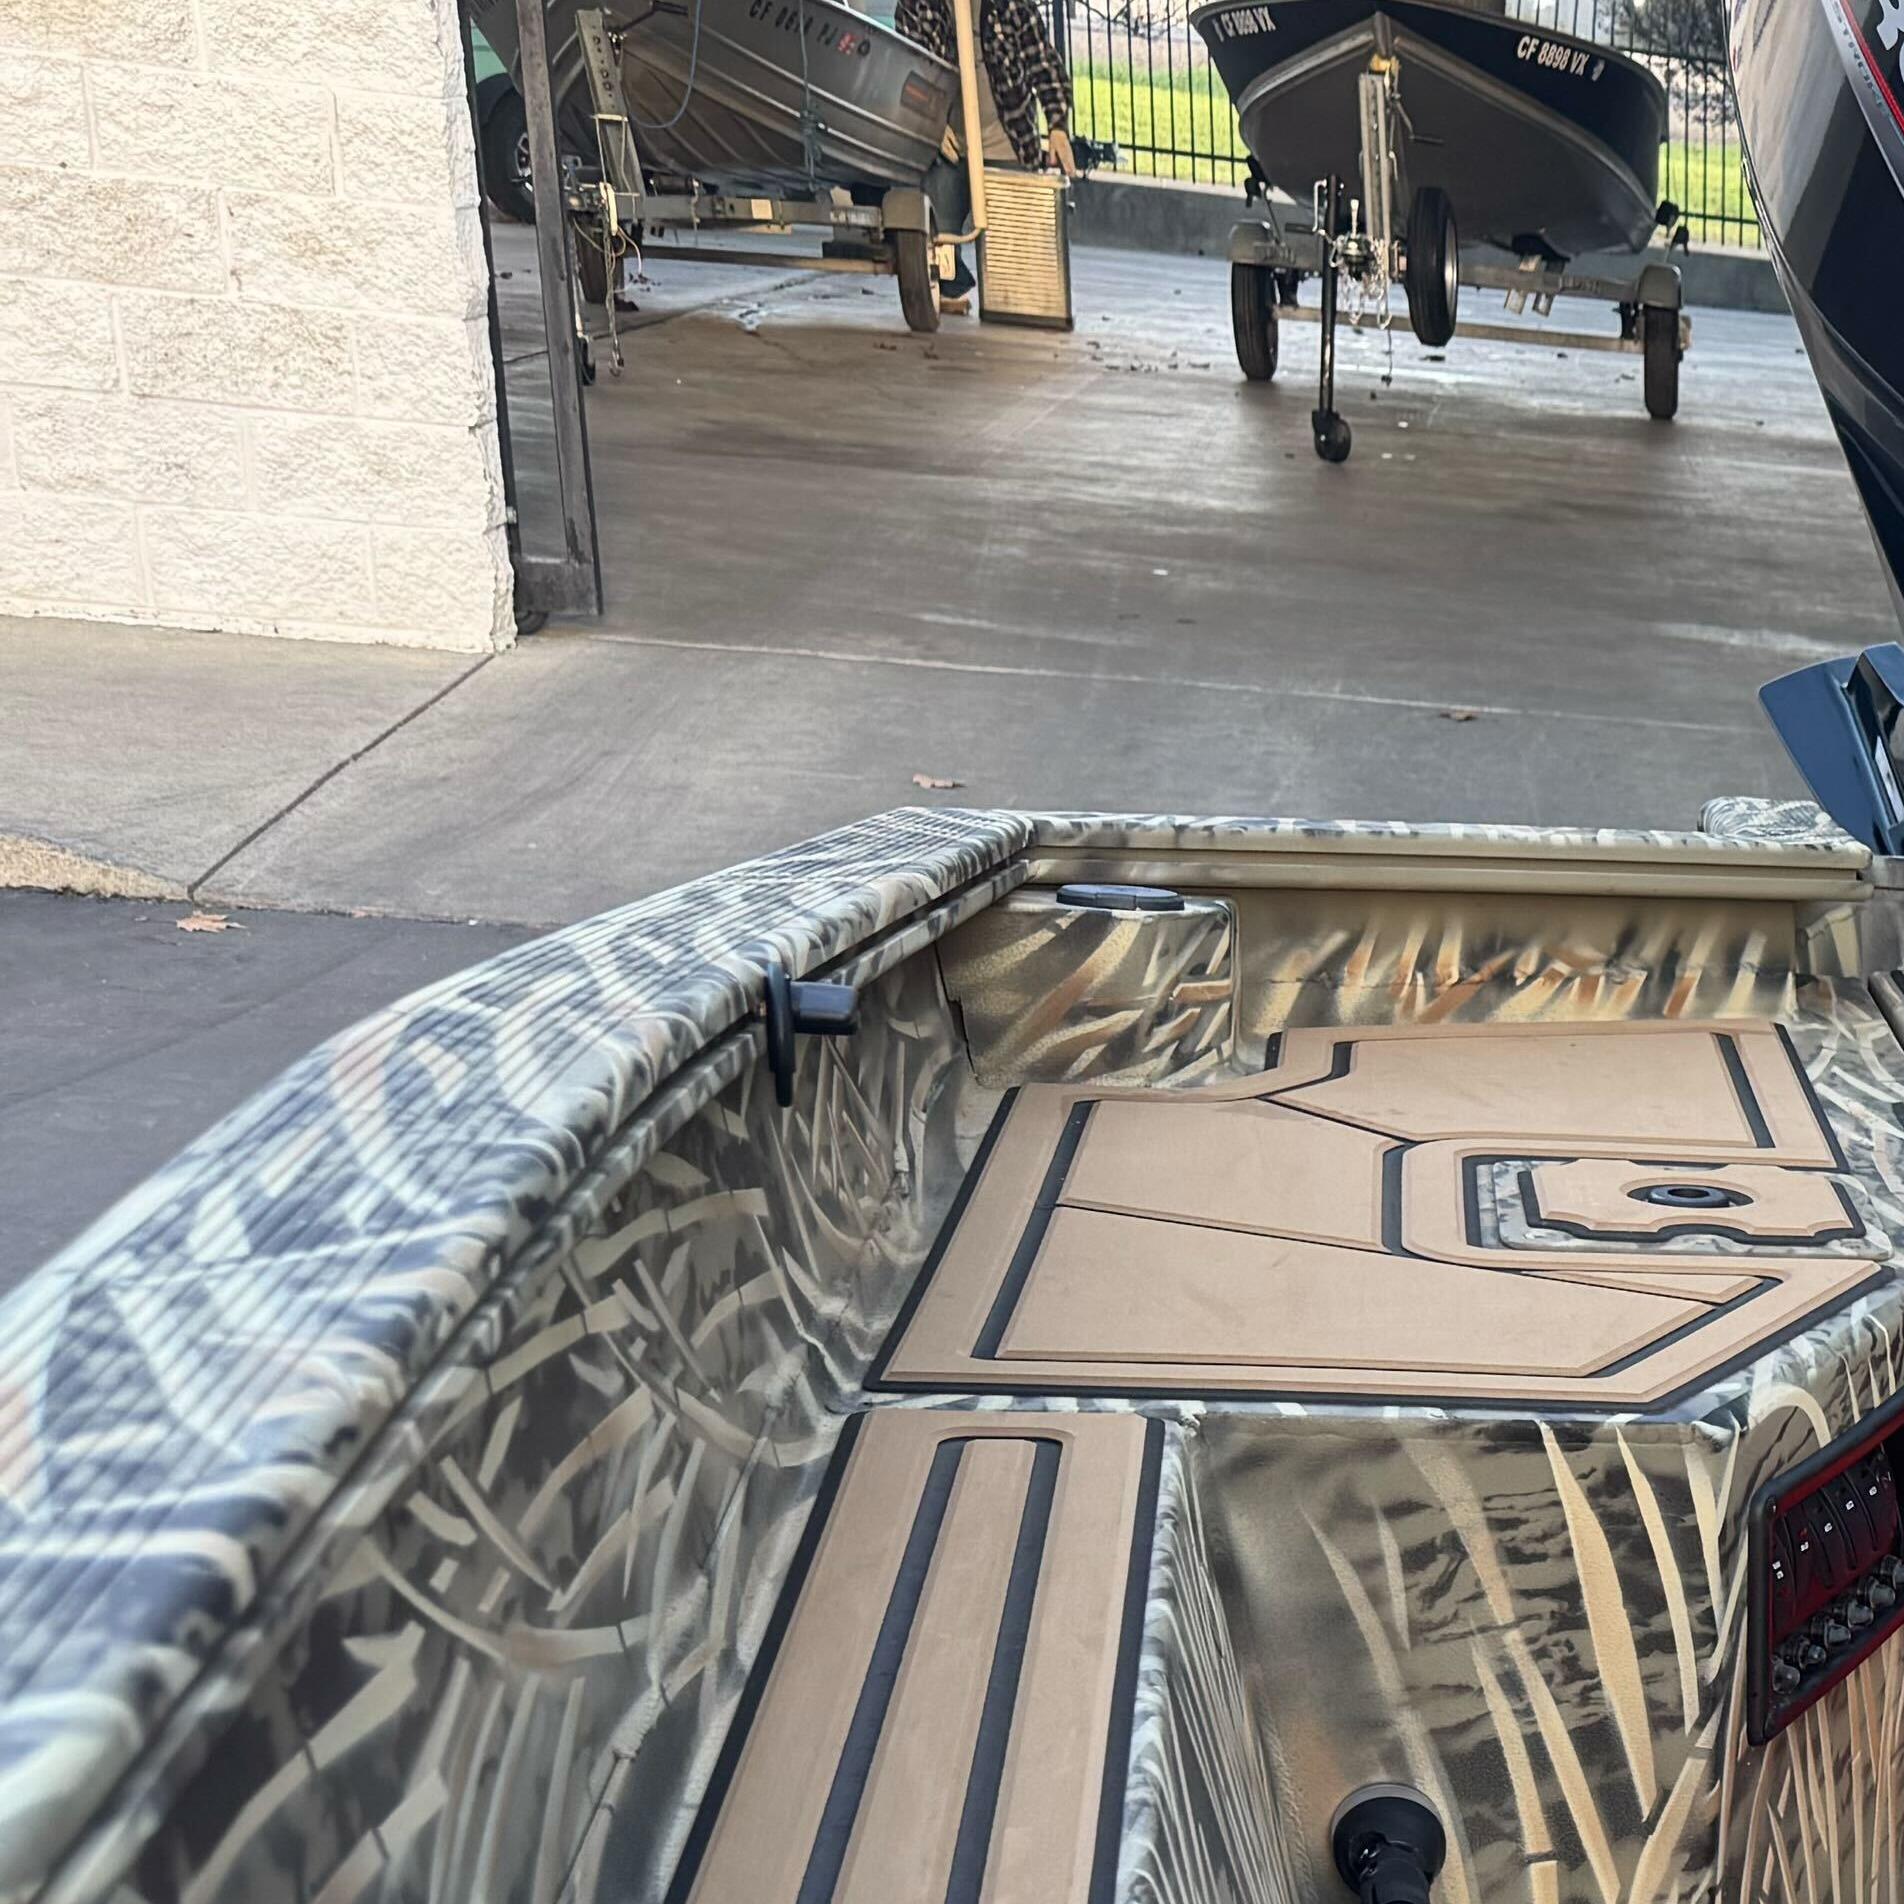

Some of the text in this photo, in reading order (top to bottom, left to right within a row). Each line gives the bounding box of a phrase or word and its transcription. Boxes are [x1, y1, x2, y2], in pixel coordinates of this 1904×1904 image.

[1517, 35, 1591, 76] CF 8898 VX
